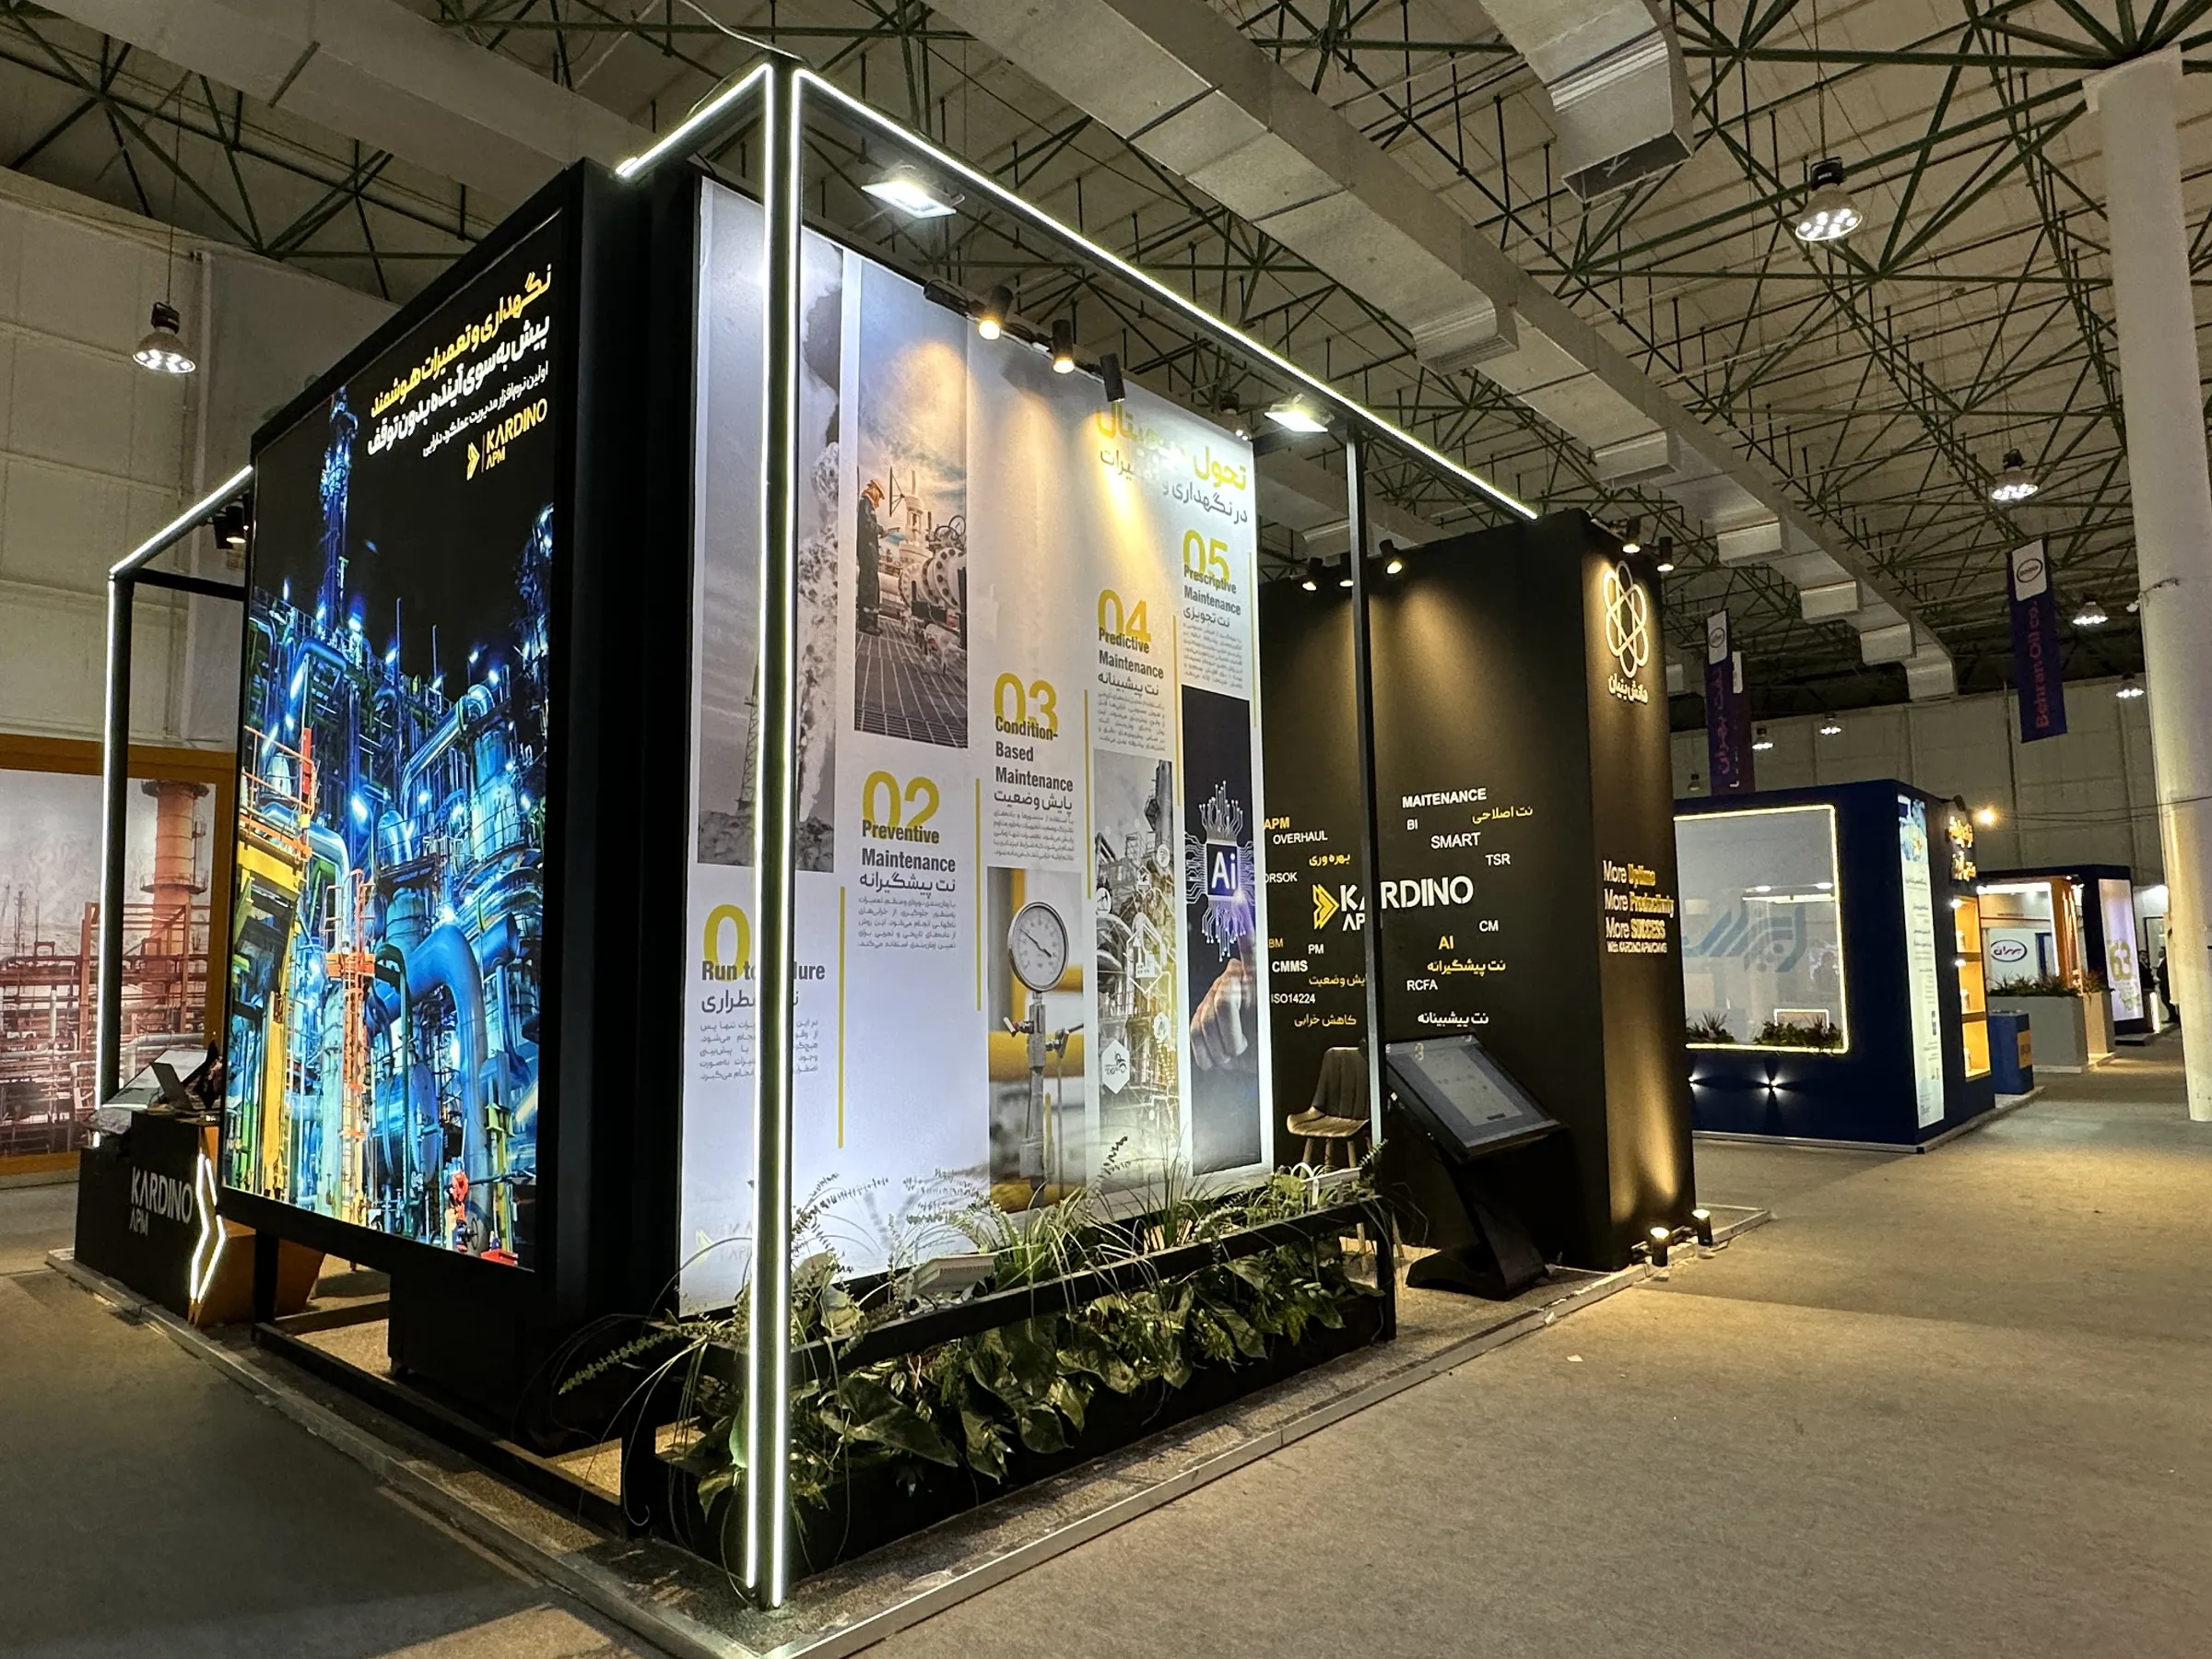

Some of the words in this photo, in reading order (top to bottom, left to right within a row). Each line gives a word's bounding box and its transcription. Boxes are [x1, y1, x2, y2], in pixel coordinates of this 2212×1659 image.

[480, 263, 551, 343] نگهداری
[471, 324, 480, 353] و
[511, 315, 550, 361] پیش
[421, 324, 471, 381] تعمیرات
[496, 341, 511, 372] به
[463, 353, 497, 396] سوی
[526, 359, 548, 390] اولین
[371, 367, 421, 418] هوشمند
[430, 362, 465, 412] آینده
[397, 399, 430, 440] بدون
[487, 398, 547, 453] KARDINO
[368, 415, 399, 455] توقف
[486, 446, 505, 470] APM
[1193, 445, 1246, 491] تحول
[1162, 480, 1170, 495] و
[1172, 482, 1232, 517] نگهداری
[1233, 510, 1248, 524] در
[1182, 529, 1230, 585] 05
[1183, 564, 1237, 594] Prescriptive
[1183, 585, 1241, 616] Maintenance
[1098, 589, 1151, 641] 04
[1218, 612, 1230, 628] نت
[1098, 627, 1149, 654] Predictive
[1099, 650, 1164, 680] Maintenance
[1144, 683, 1159, 696] نت
[2032, 659, 2050, 729] Behran
[994, 672, 1058, 733] 03
[994, 715, 1059, 741] Condition-
[995, 740, 1034, 762] Based
[995, 766, 1073, 793] Maintenance
[863, 771, 939, 838] 02
[994, 791, 1040, 811] وضعیت
[1041, 794, 1073, 818] پایش
[1402, 788, 1488, 809] MAITENANCE
[1263, 817, 1290, 830] APM
[1406, 818, 1418, 830] BI
[1472, 805, 1514, 824] اصلاحی
[1515, 806, 1534, 818] نت
[862, 819, 939, 844] Preventive
[1272, 830, 1328, 844] OVERHAUL
[1430, 831, 1481, 849] SMART
[862, 848, 956, 873] Maintenance
[1309, 854, 1328, 866] وری
[1328, 853, 1351, 866] بهره
[1485, 853, 1512, 866] TSR
[1603, 859, 1628, 884] More
[859, 871, 933, 899] پیشگیرانه
[935, 878, 956, 892] نت
[1604, 888, 1629, 912] More
[1478, 920, 1499, 932] CM
[1605, 916, 1630, 939] More
[1630, 918, 1666, 940] SUCCESS
[703, 904, 751, 983] 0
[1308, 944, 1324, 955] PM
[1438, 935, 1454, 949] AI
[701, 960, 737, 981] Run
[1272, 959, 1309, 972] CMMS
[1427, 958, 1486, 977] پیشگیرانه
[1487, 959, 1506, 971] نت
[1309, 974, 1346, 988] وضعیت
[1406, 979, 1439, 992] RCFA
[1271, 994, 1316, 1005] ISO14224
[1293, 1013, 1321, 1028] خرابی
[1322, 1014, 1358, 1027] کاهش
[1471, 1012, 1489, 1025] نت
[131, 1166, 193, 1225] KARDINO
[129, 1206, 149, 1237] APM
